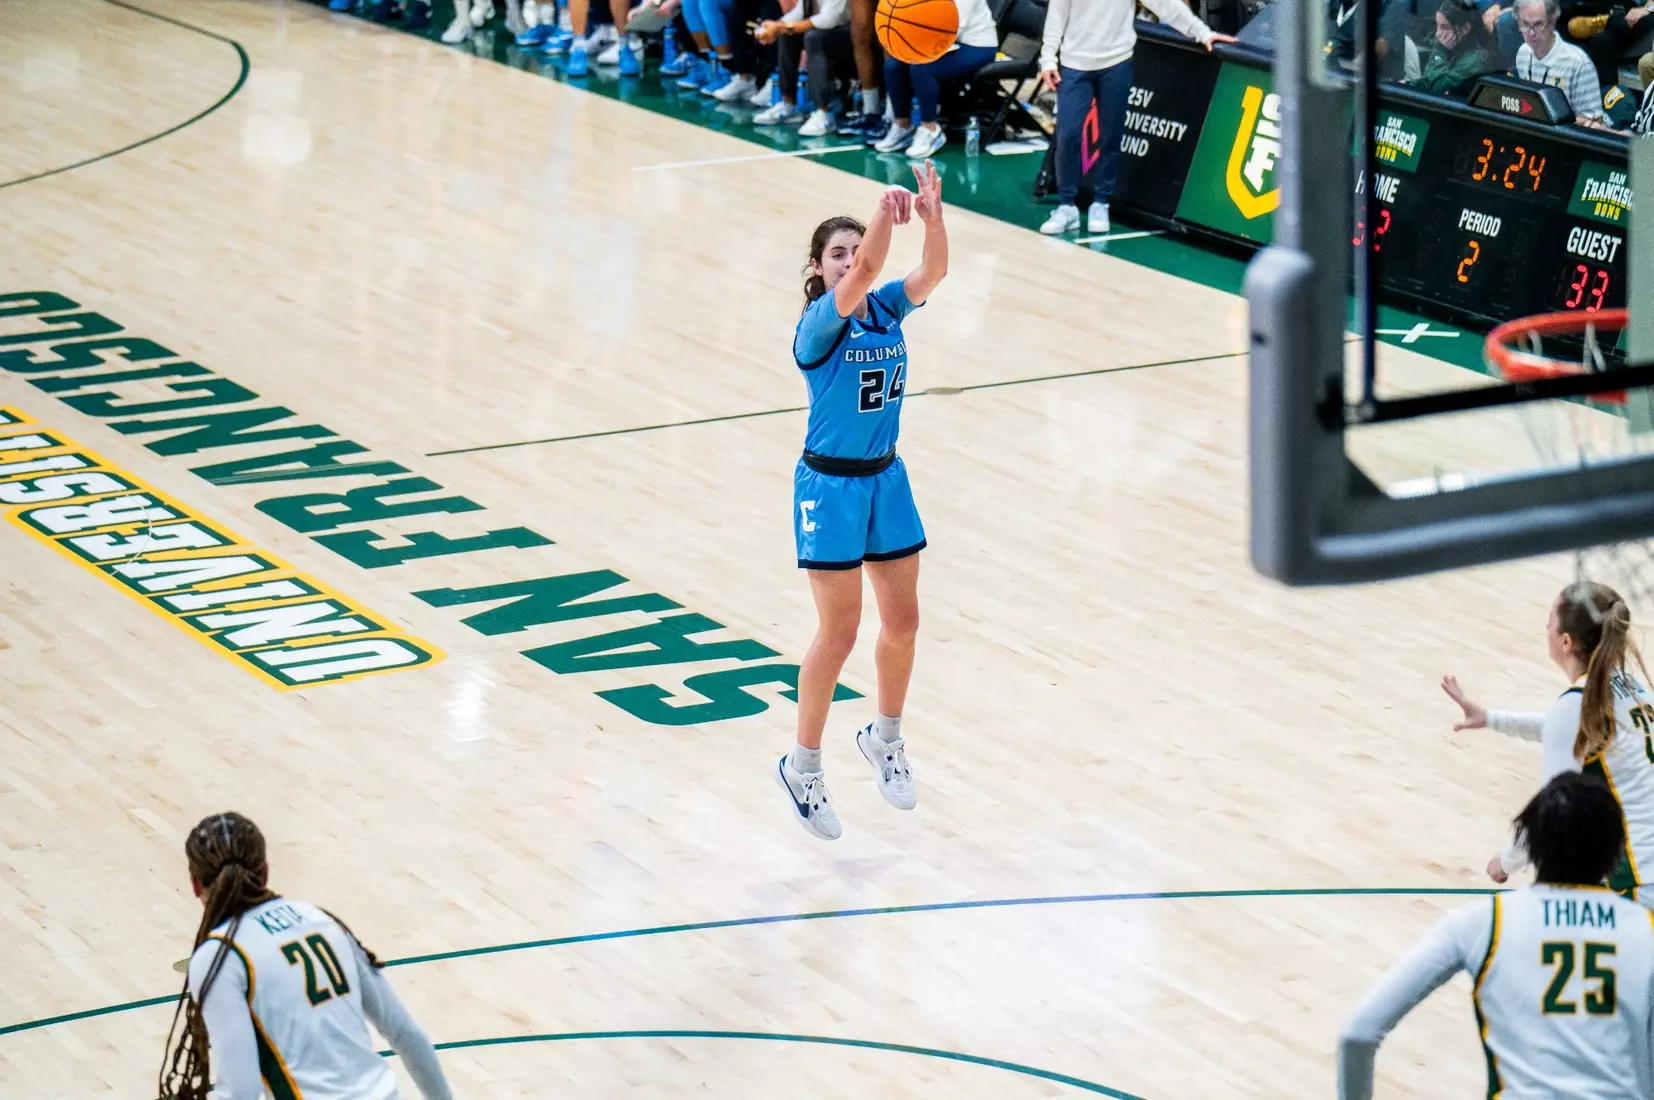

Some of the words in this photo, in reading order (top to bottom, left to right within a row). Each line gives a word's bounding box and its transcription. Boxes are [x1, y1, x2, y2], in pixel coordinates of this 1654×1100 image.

[1127, 86, 1154, 108] 25V
[1501, 96, 1520, 113] POSS
[1386, 115, 1403, 132] SAN
[1120, 134, 1150, 157] UND
[1374, 125, 1417, 157] RANCISCO
[1472, 138, 1547, 191] 3:24
[1608, 171, 1628, 185] SAN
[1355, 170, 1400, 204] HME
[1580, 178, 1635, 211] FRANCISC
[1458, 208, 1502, 237] PERIOD
[1594, 203, 1621, 221] DONS
[1566, 226, 1622, 263] GUEST
[1457, 240, 1480, 283] 2
[1565, 264, 1609, 313] 33
[845, 341, 907, 362] COLUMBI
[858, 362, 905, 413] 24
[800, 500, 816, 532] C
[0, 408, 434, 687] UNIVERSI
[1540, 898, 1616, 929] THIAM
[279, 932, 351, 1007] 20
[1539, 940, 1618, 1016] 25
